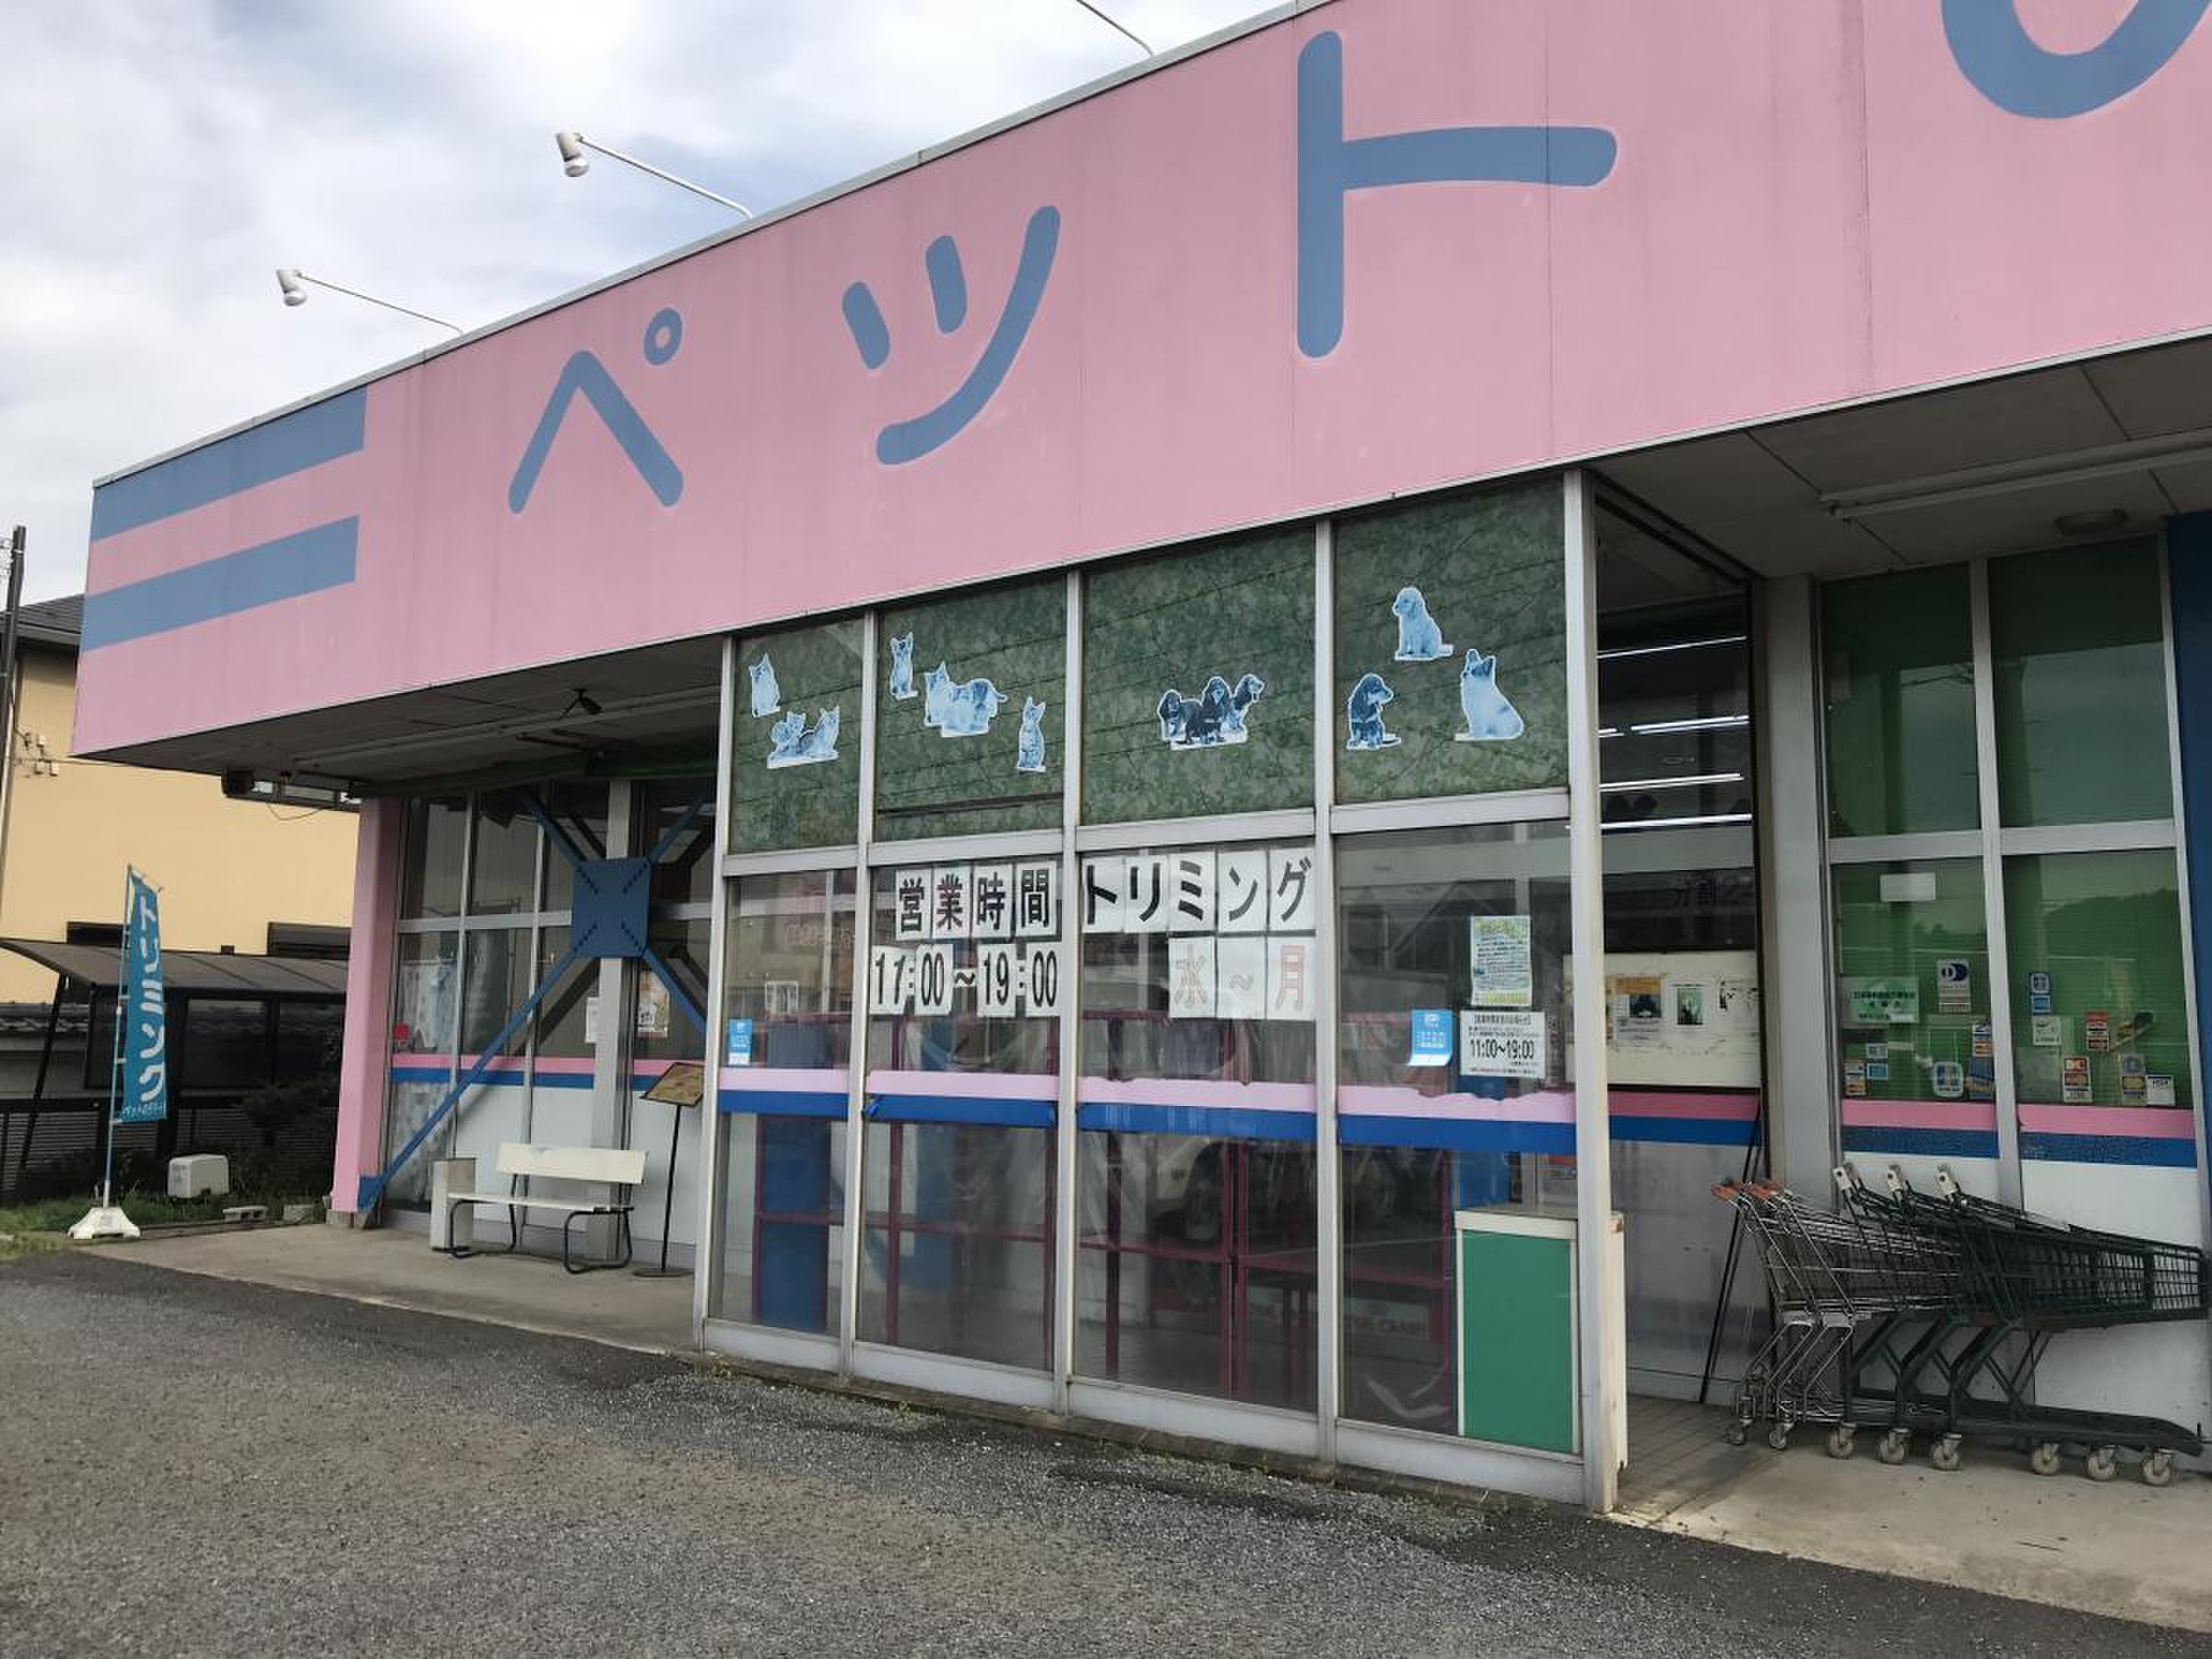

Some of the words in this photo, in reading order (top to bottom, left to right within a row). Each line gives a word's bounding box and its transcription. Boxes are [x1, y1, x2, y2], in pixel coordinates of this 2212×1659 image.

[900, 868, 1049, 933] 営業時間
[1087, 856, 1312, 924] トリミング
